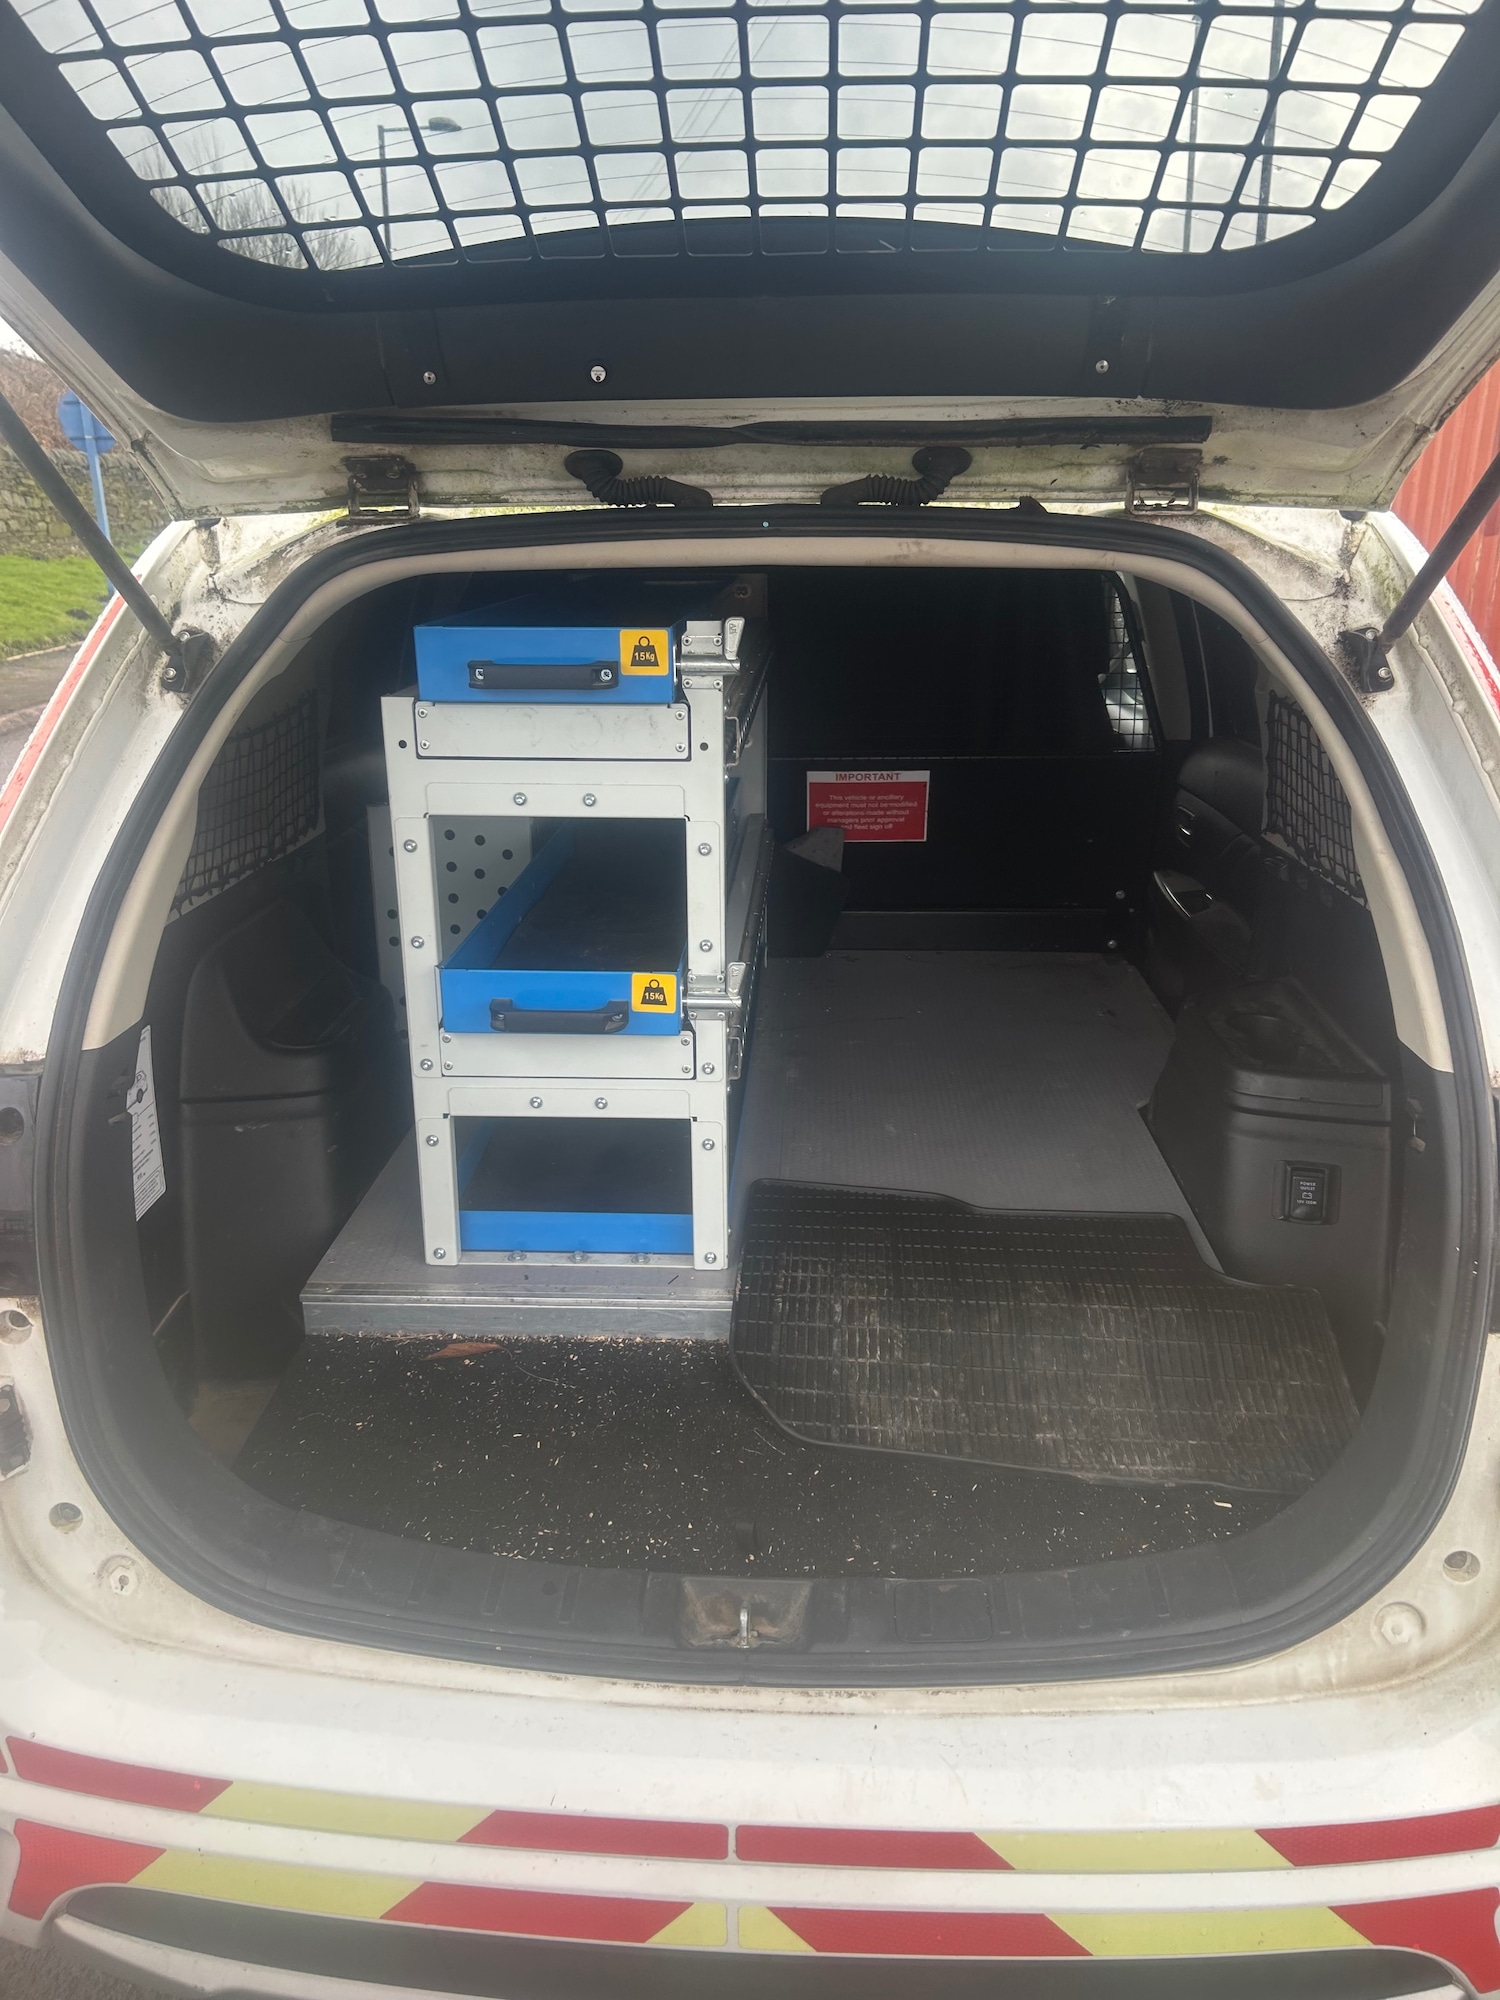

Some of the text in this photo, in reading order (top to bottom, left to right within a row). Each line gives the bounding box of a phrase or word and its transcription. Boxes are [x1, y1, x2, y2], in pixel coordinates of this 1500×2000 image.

[634, 651, 655, 663] 15Kg
[835, 772, 901, 782] IMPORTANT
[877, 794, 904, 802] ancillary
[827, 817, 860, 825] managers
[877, 816, 905, 824] approval
[644, 991, 664, 1002] 15Kg
